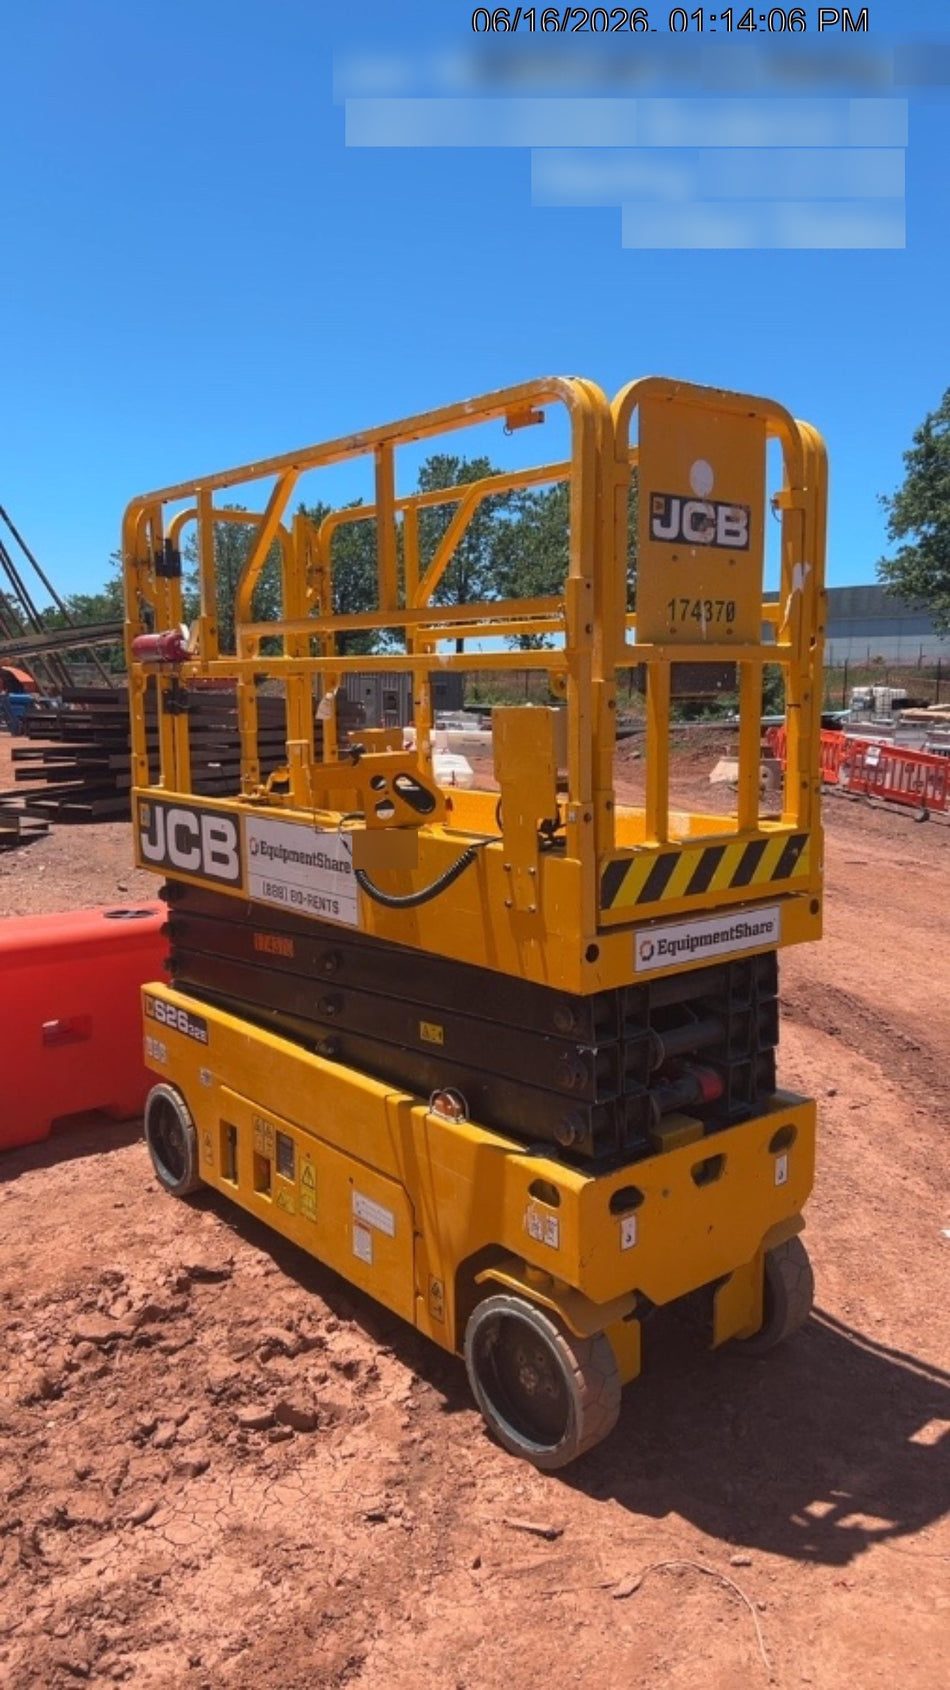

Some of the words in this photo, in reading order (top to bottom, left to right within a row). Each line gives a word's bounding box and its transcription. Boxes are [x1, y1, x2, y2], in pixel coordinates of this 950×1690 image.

[652, 499, 748, 546] JCB
[668, 599, 735, 622] 174370
[140, 805, 240, 880] JCB
[260, 840, 352, 874] EquipmentShare
[656, 920, 774, 957] EquipmentShare
